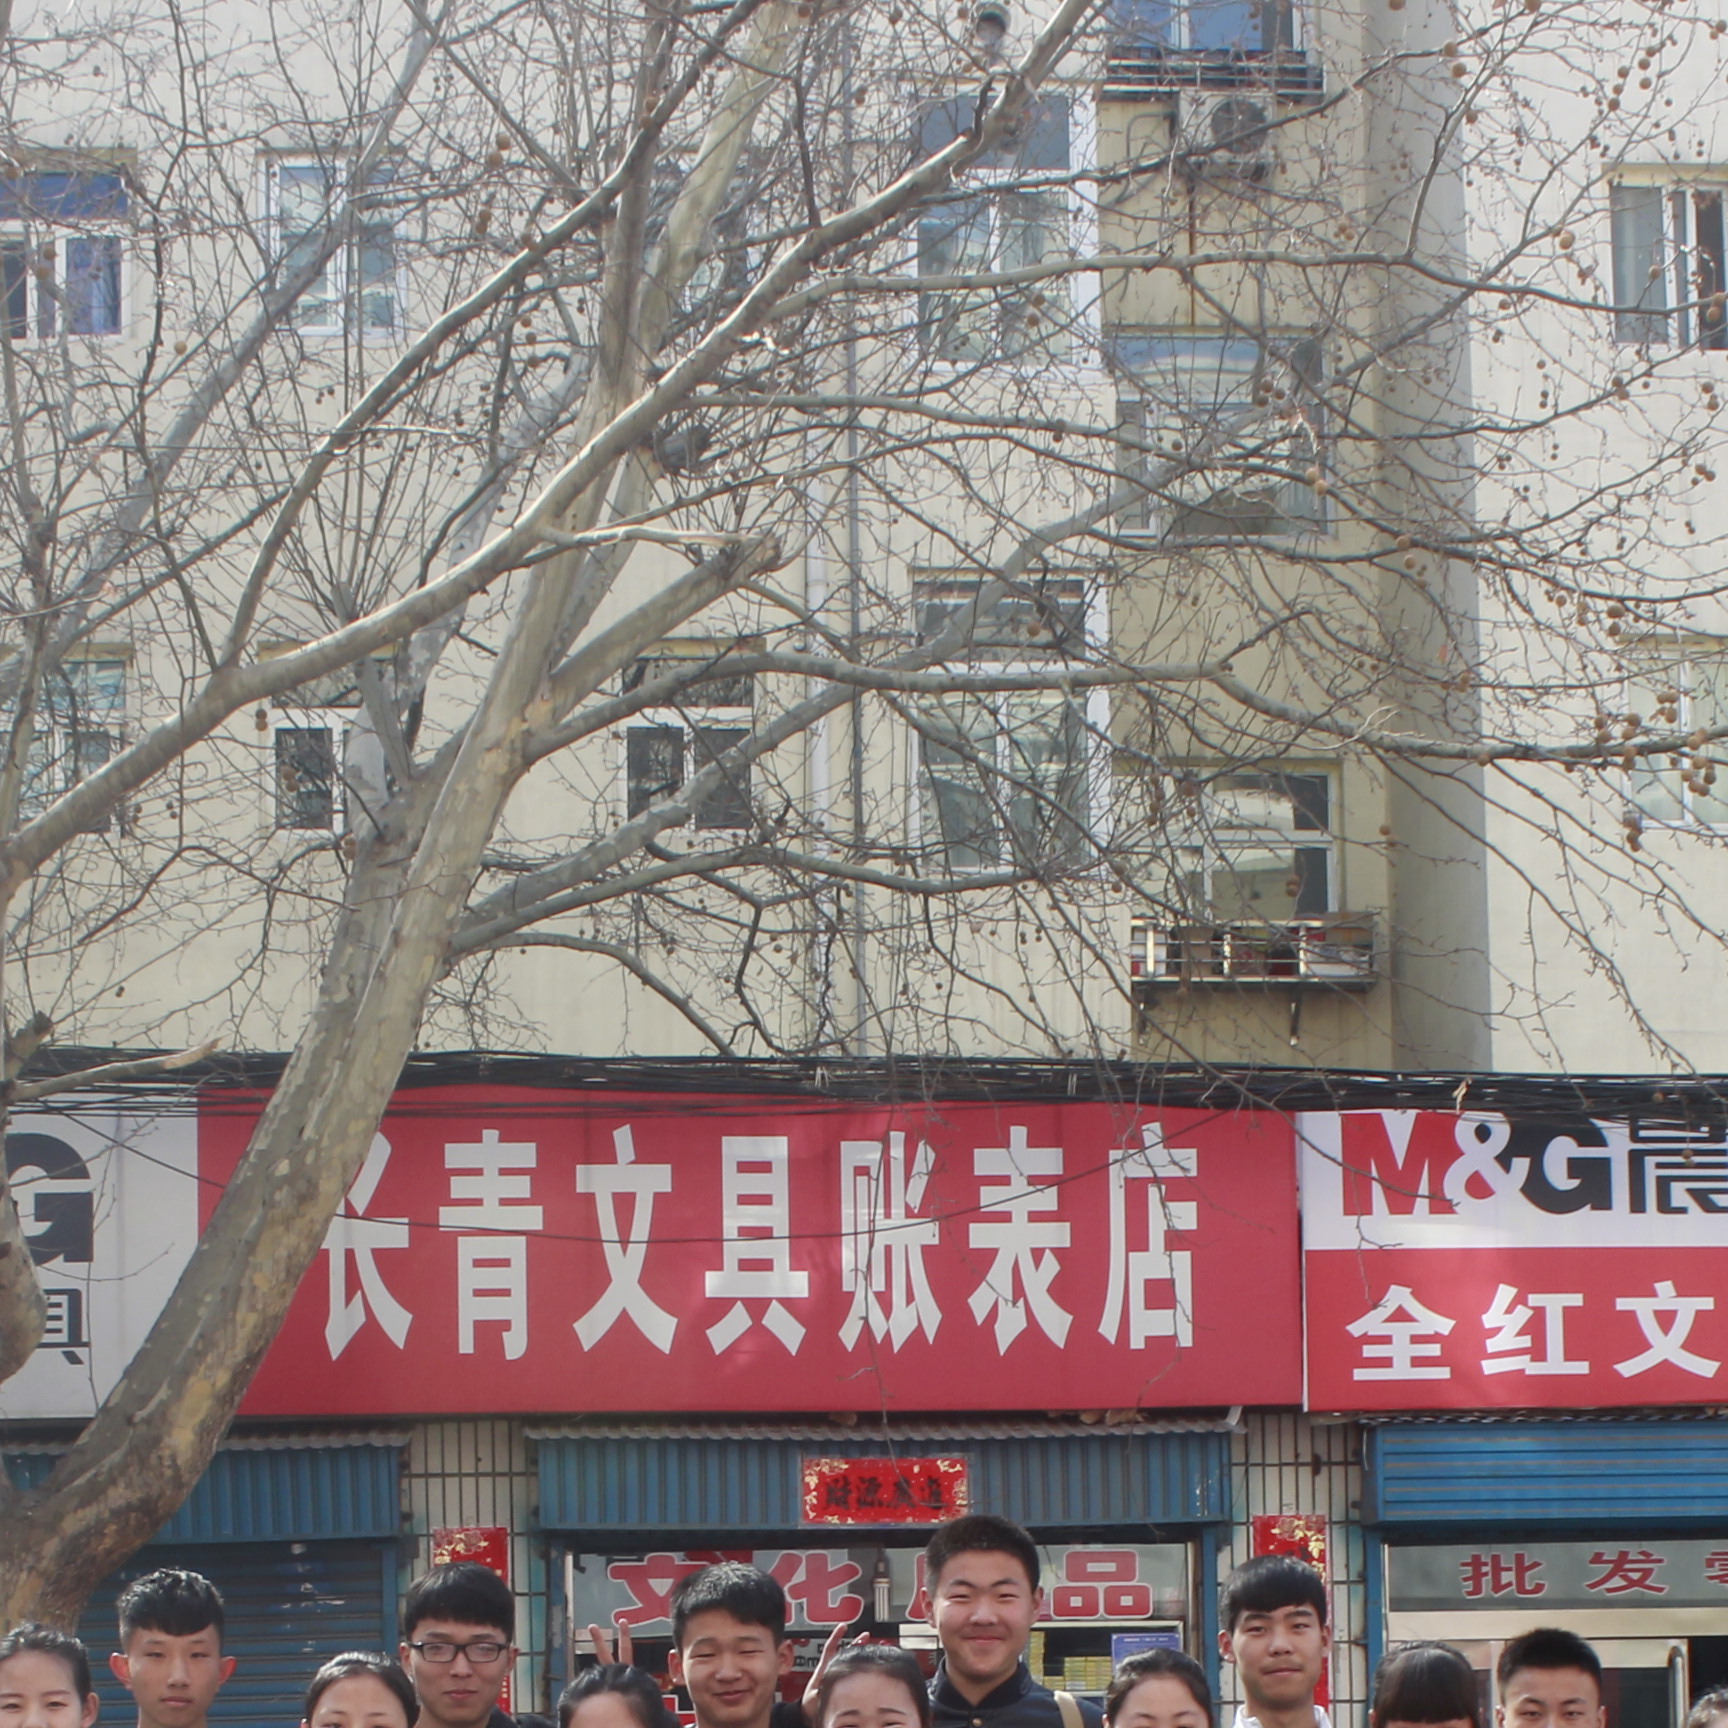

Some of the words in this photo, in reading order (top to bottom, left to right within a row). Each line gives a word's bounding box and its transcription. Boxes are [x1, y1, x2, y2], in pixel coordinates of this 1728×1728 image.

[321, 1121, 1199, 1362] 长青文具账表店
[608, 1549, 1153, 1627] 文化品
